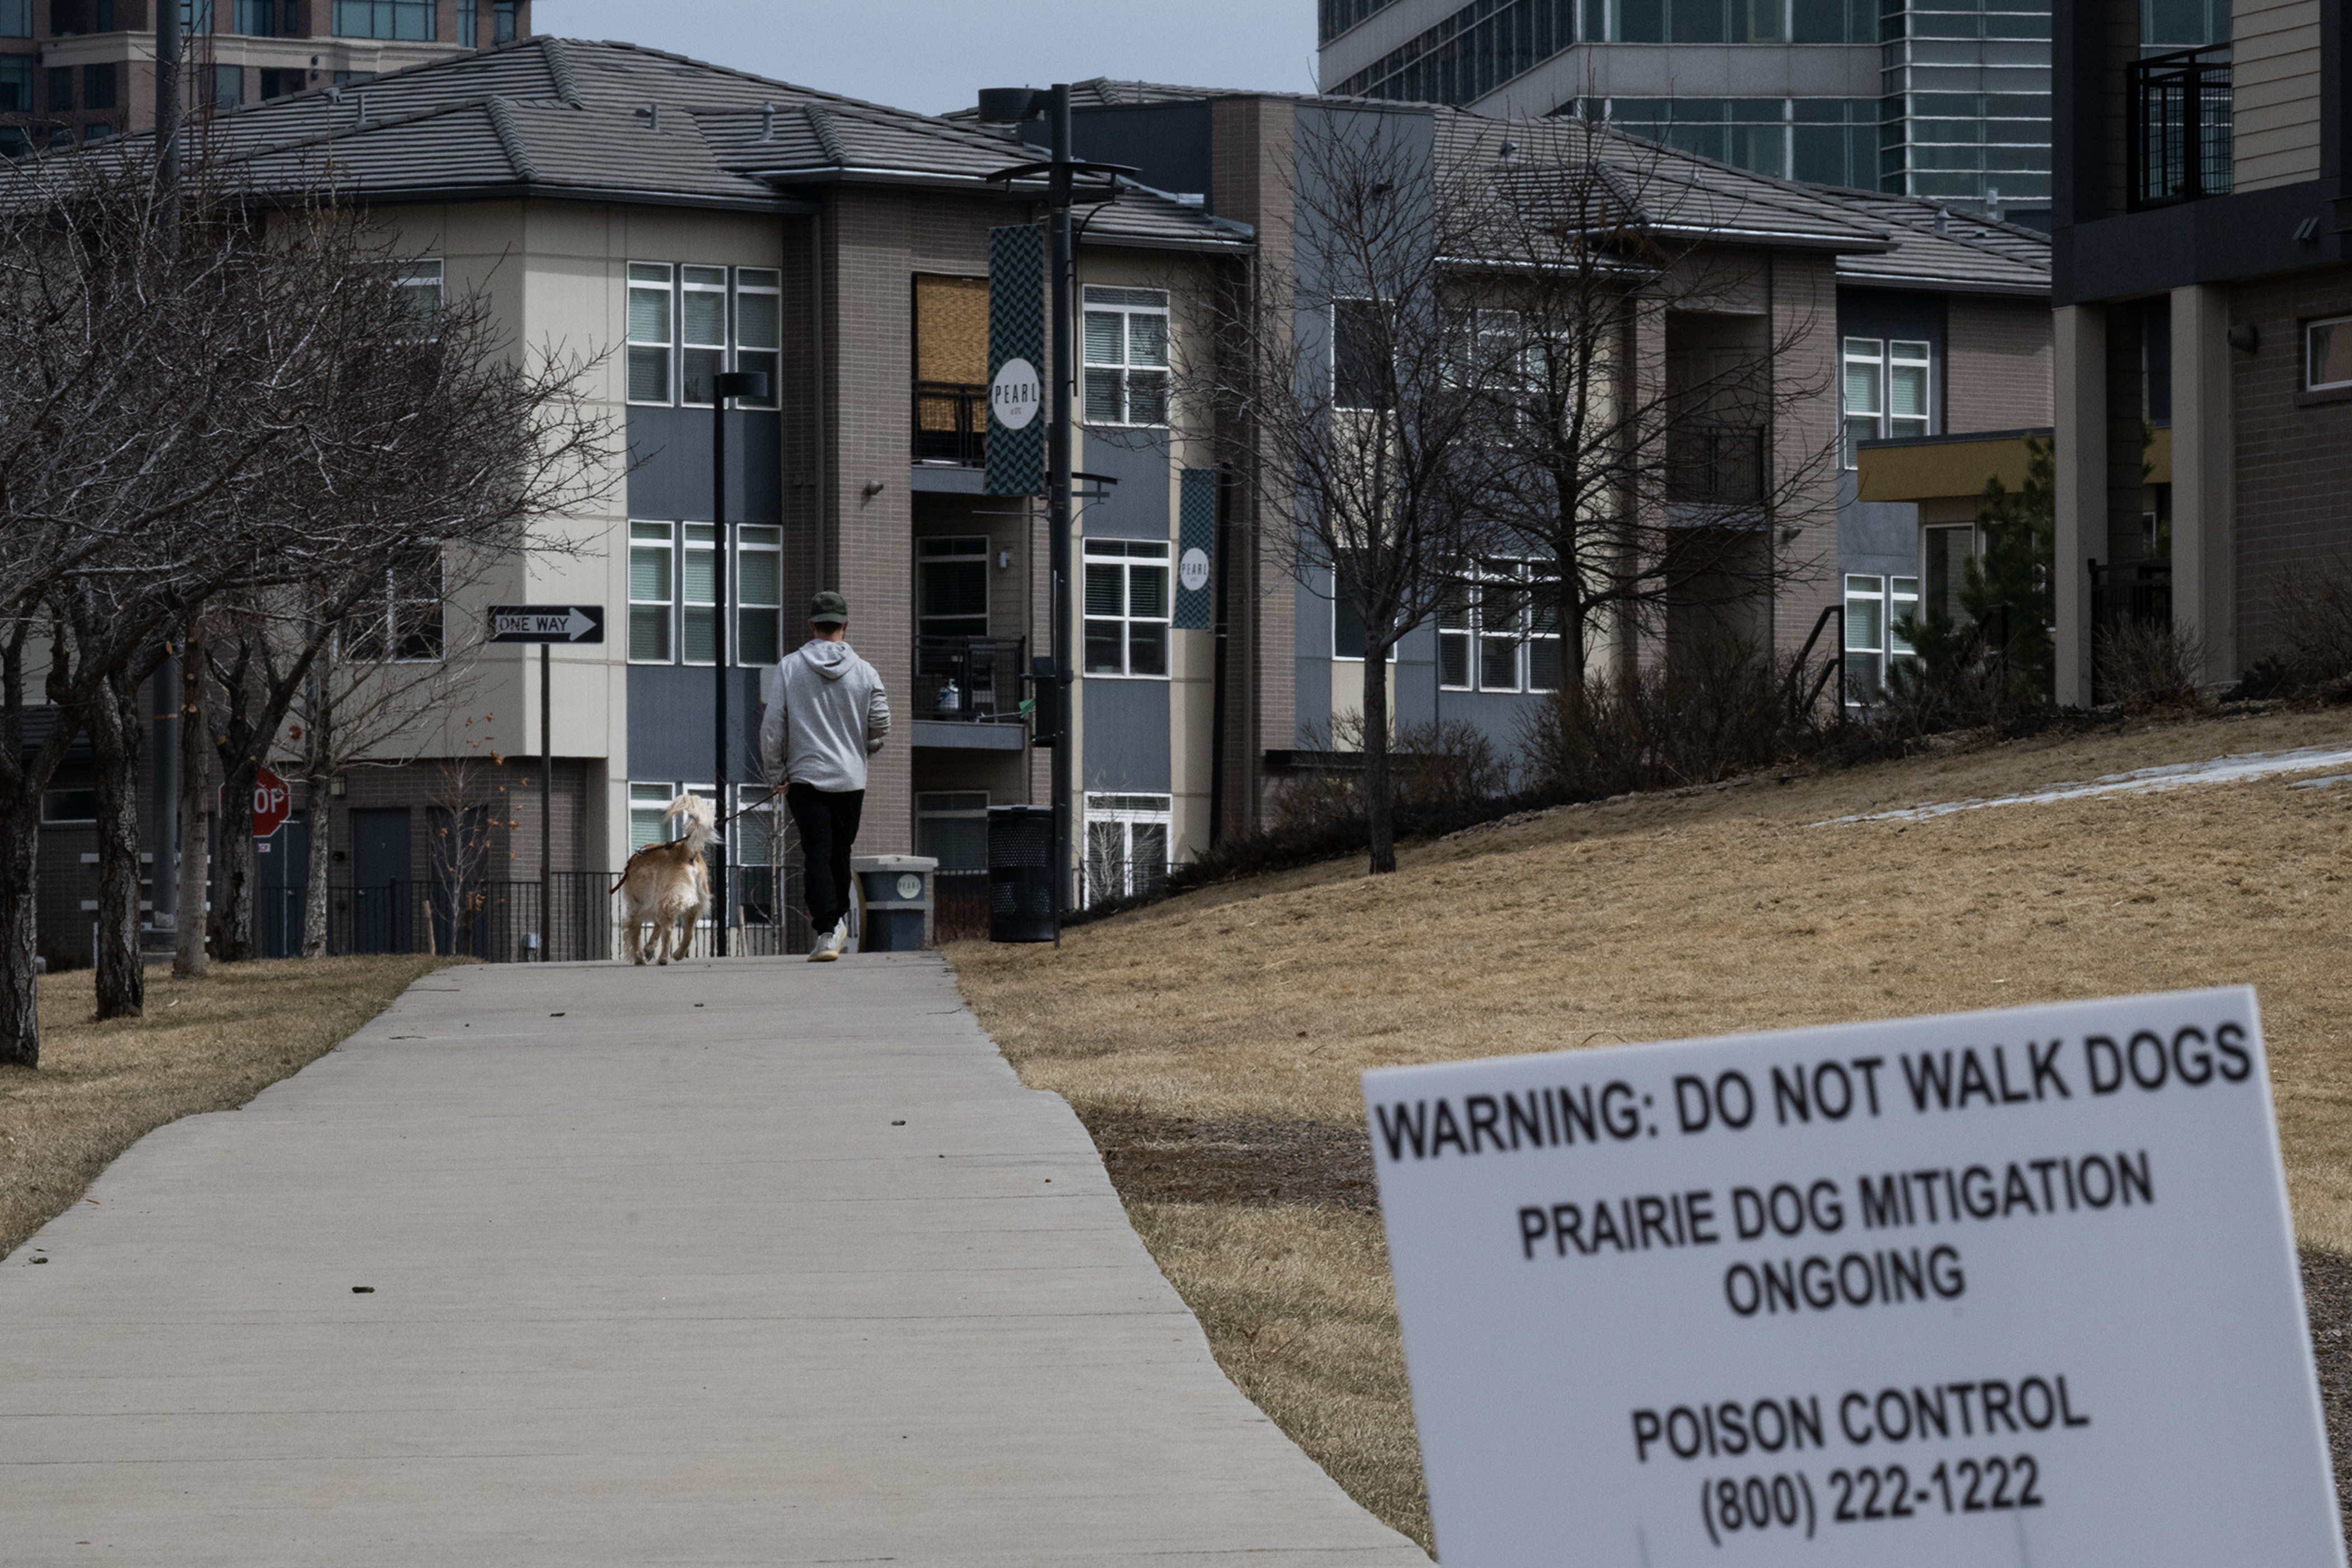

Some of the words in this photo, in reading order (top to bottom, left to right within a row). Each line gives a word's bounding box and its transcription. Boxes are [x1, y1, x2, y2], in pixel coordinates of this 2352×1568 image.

[995, 383, 1037, 404] PEARL
[1181, 563, 1207, 575] PEARL
[500, 617, 530, 631] ONE
[536, 617, 568, 631] WAY
[254, 788, 284, 813] OP
[1376, 1081, 1658, 1161] WARNING:
[1673, 1070, 1756, 1134] DO
[1771, 1057, 1884, 1125] NOT
[1900, 1035, 2071, 1112] WALK
[2084, 1021, 2252, 1096] DOGS
[1518, 1191, 1720, 1260] PRAIRIE
[1732, 1179, 1845, 1241] DOG
[1858, 1150, 2154, 1229] MITIGATION
[1724, 1244, 1966, 1318] ONGOING
[1631, 1396, 1824, 1462] POISON
[1838, 1375, 2090, 1446] CONTROL
[1701, 1473, 1816, 1546] (800)
[1828, 1454, 2044, 1523] 222-1222
